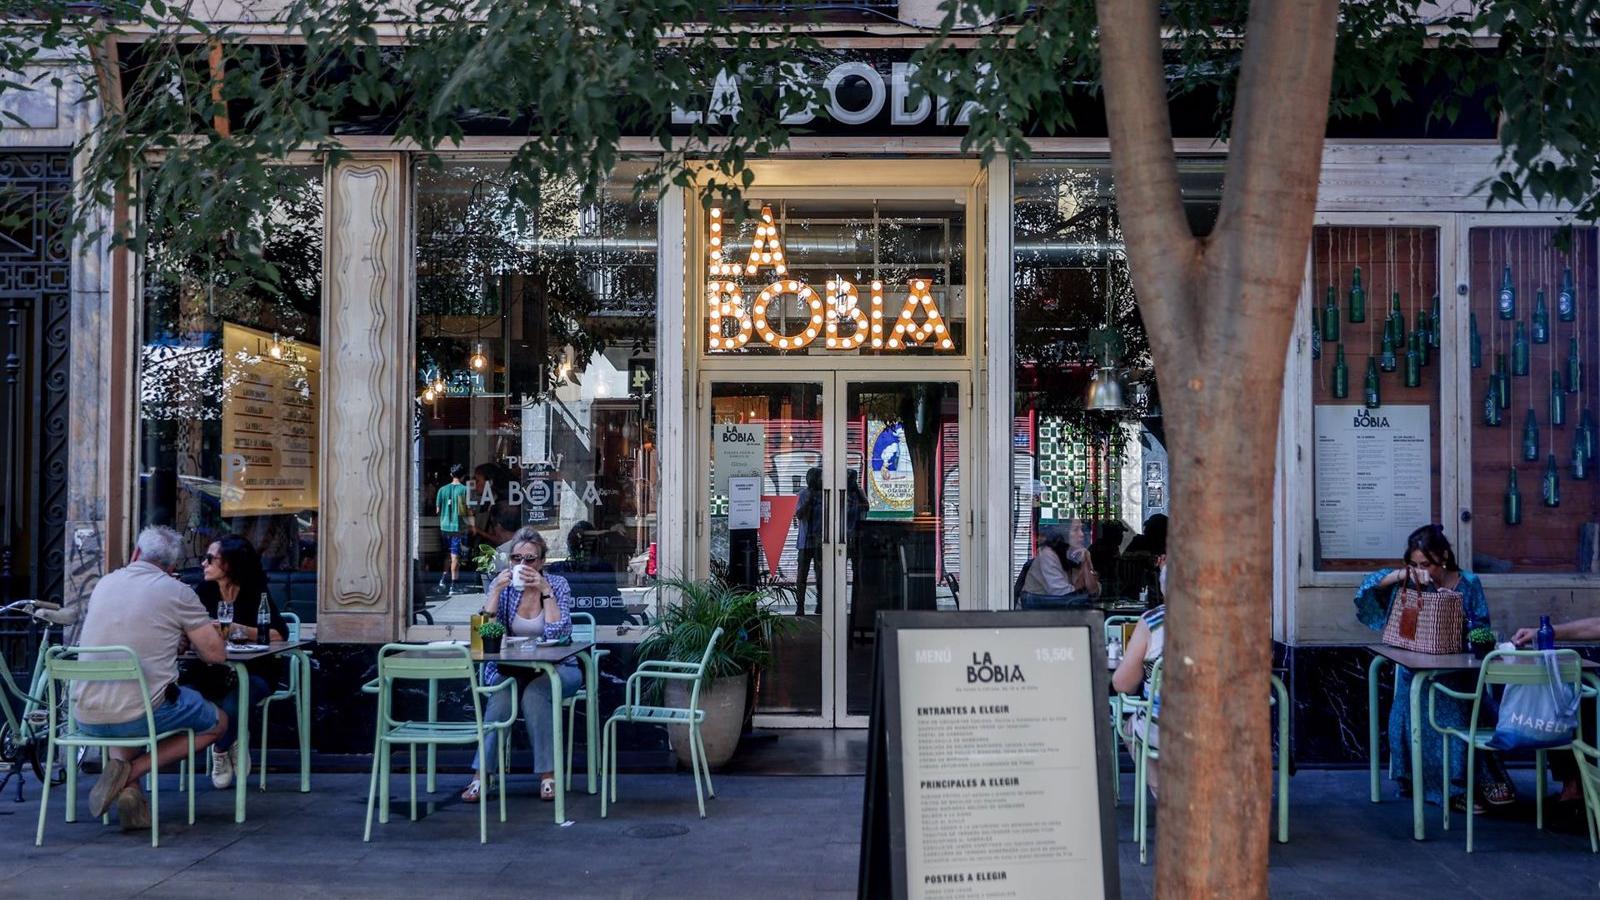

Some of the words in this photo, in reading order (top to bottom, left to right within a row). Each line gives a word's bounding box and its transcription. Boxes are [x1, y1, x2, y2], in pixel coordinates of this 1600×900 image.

[709, 207, 787, 276] LA
[708, 279, 955, 350] BOBIA
[1357, 409, 1370, 417] LA
[726, 425, 738, 433] LA
[1353, 416, 1390, 428] BOBIA
[722, 432, 756, 442] BOBIA
[466, 480, 495, 506] LA
[915, 647, 952, 664] MENÚ
[972, 651, 993, 665] LA
[966, 665, 1026, 684] BOBIA
[917, 705, 968, 716] ENTRANTES
[979, 705, 1010, 715] ELEGIR
[920, 778, 978, 789] PRINCIPALES
[989, 776, 1020, 787] ELEGIR
[924, 873, 965, 884] POSTRES
[976, 870, 1008, 881] ELEGIR
